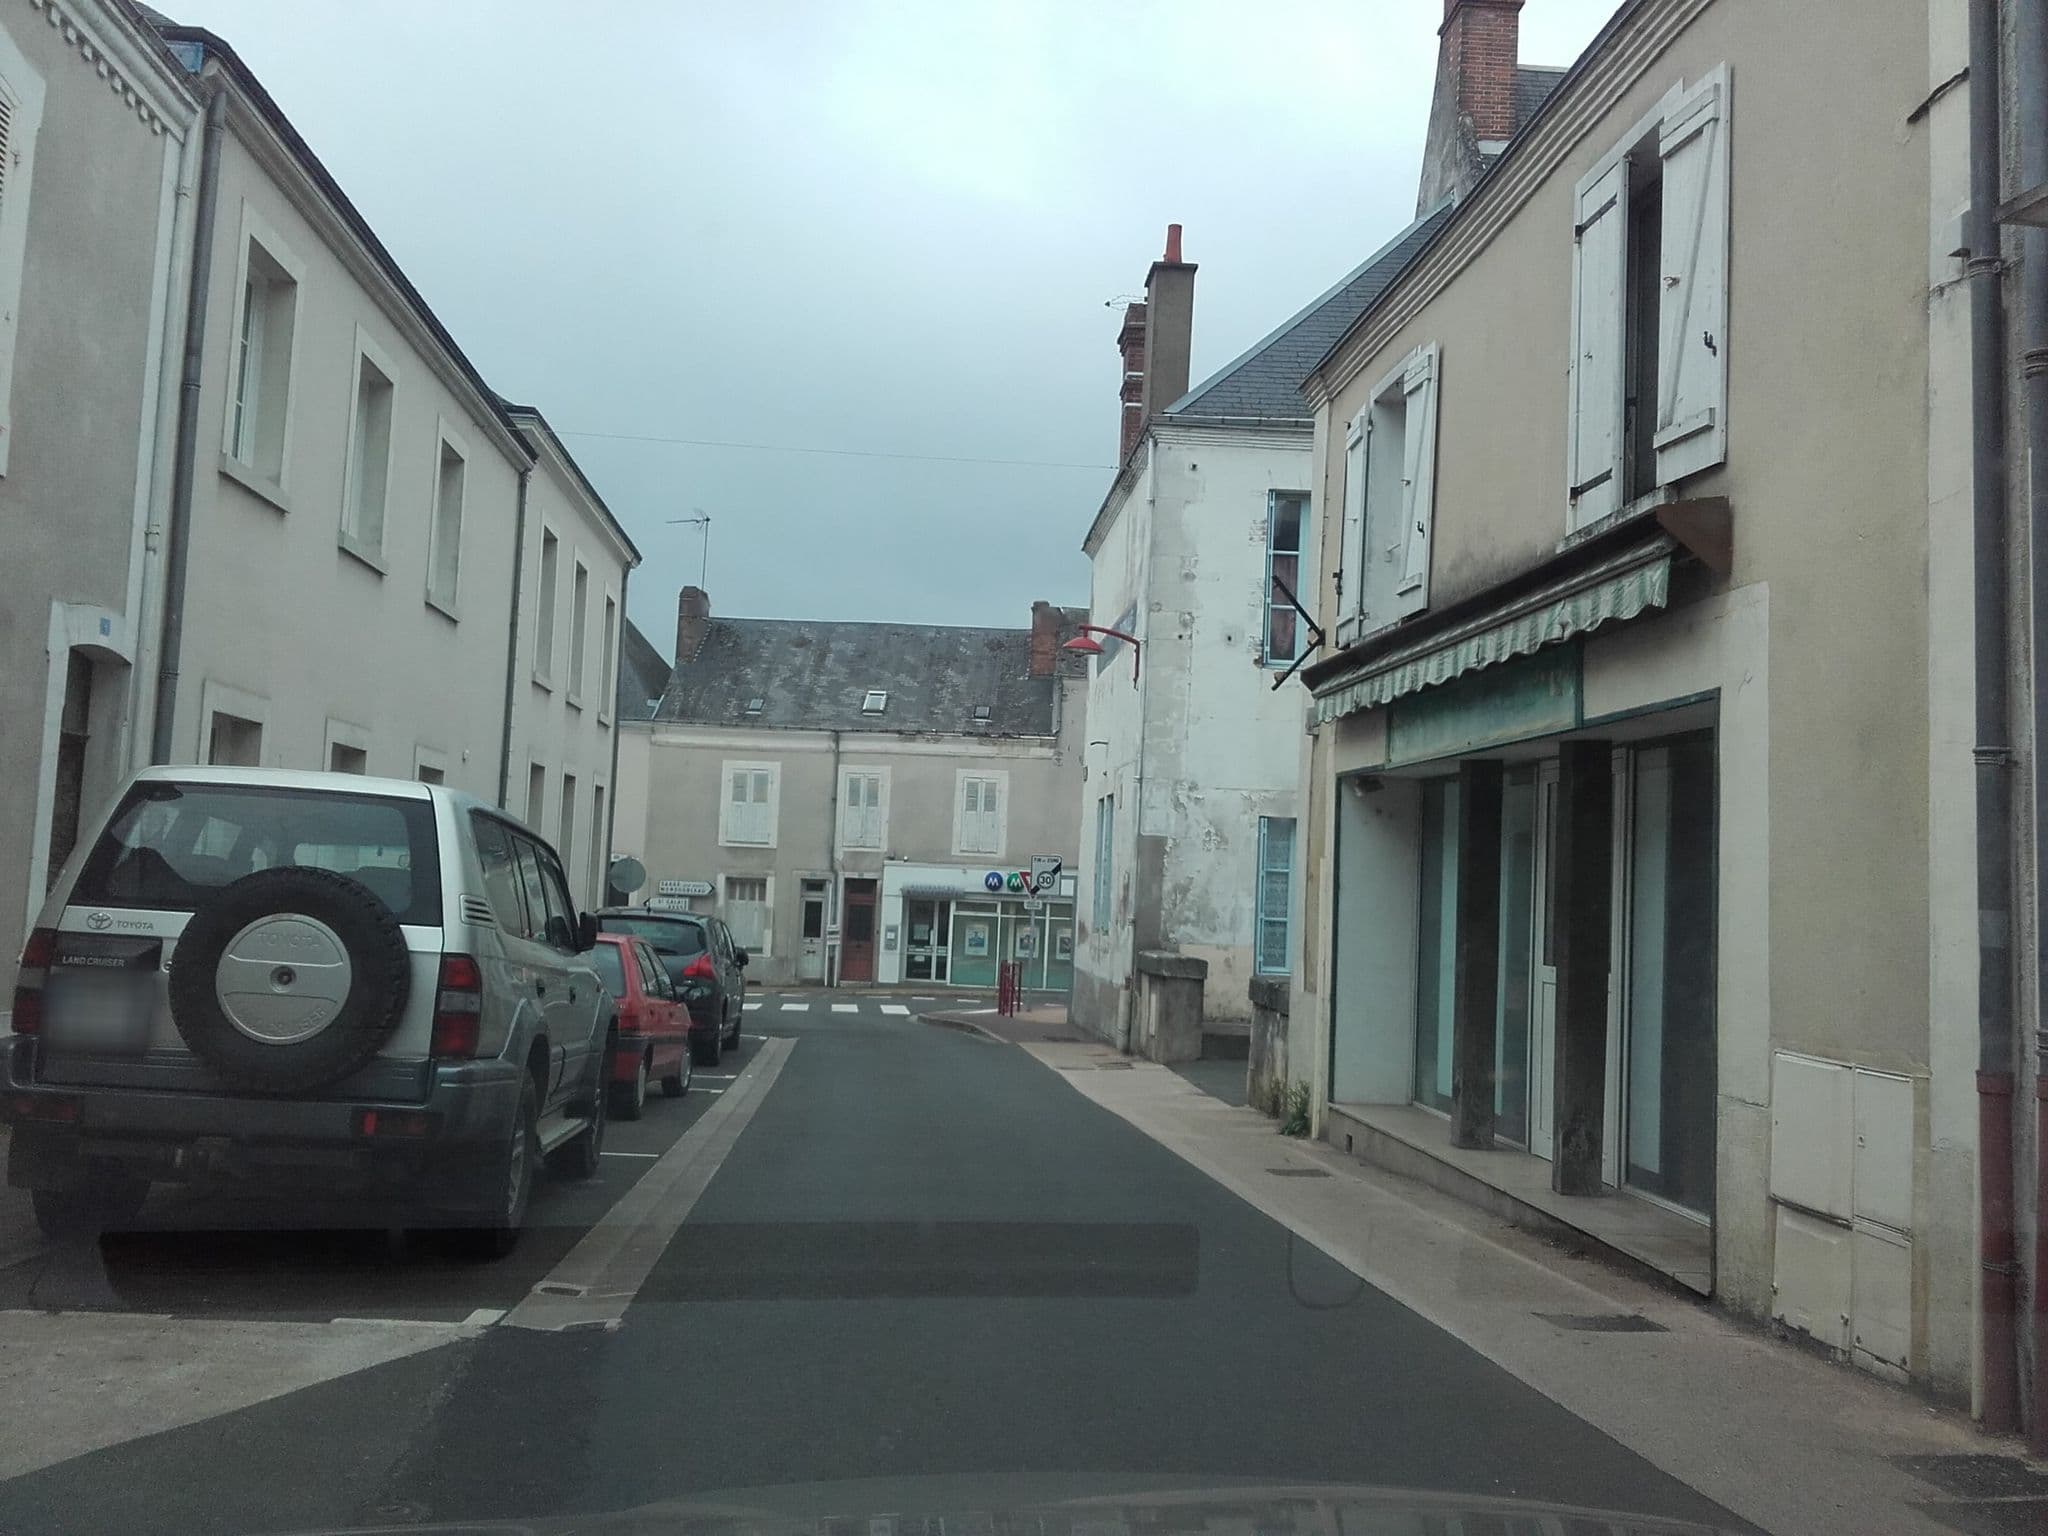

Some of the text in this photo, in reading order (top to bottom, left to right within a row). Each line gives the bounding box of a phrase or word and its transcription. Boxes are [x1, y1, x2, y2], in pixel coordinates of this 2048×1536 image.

[988, 877, 999, 886] M
[1040, 876, 1051, 884] 30
[116, 920, 154, 930] TOYOTA
[62, 956, 125, 967] LAND CRUISER
